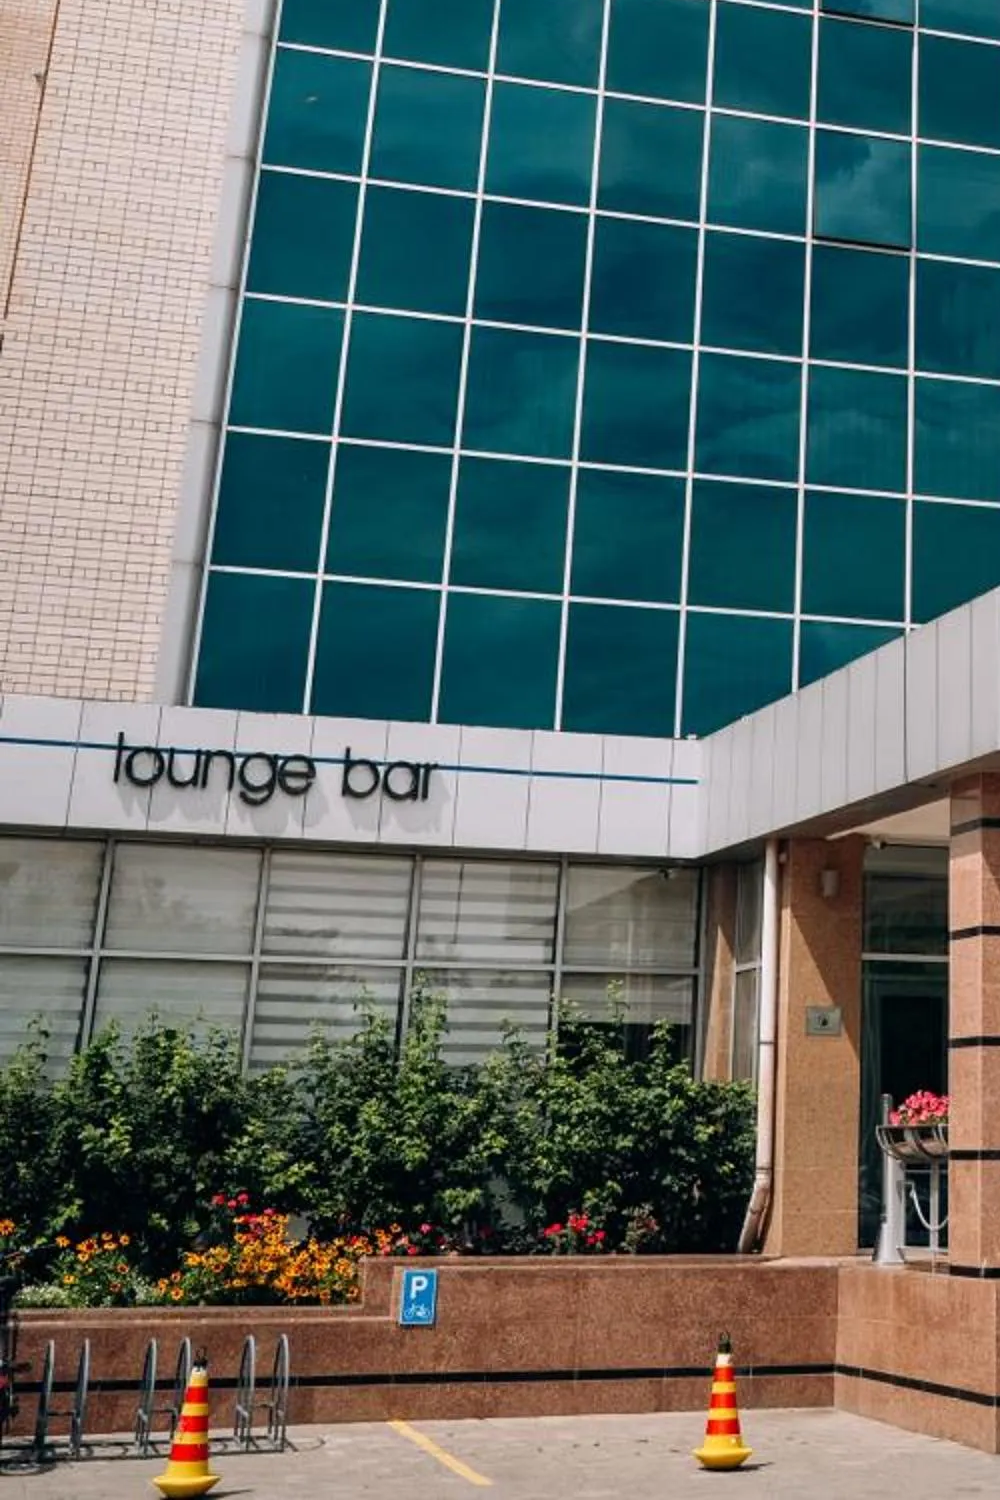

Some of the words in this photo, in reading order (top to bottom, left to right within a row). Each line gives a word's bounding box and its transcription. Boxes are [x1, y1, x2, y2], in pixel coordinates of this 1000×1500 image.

[114, 731, 316, 804] lounge
[340, 747, 438, 802] bar
[410, 1275, 428, 1299] P
